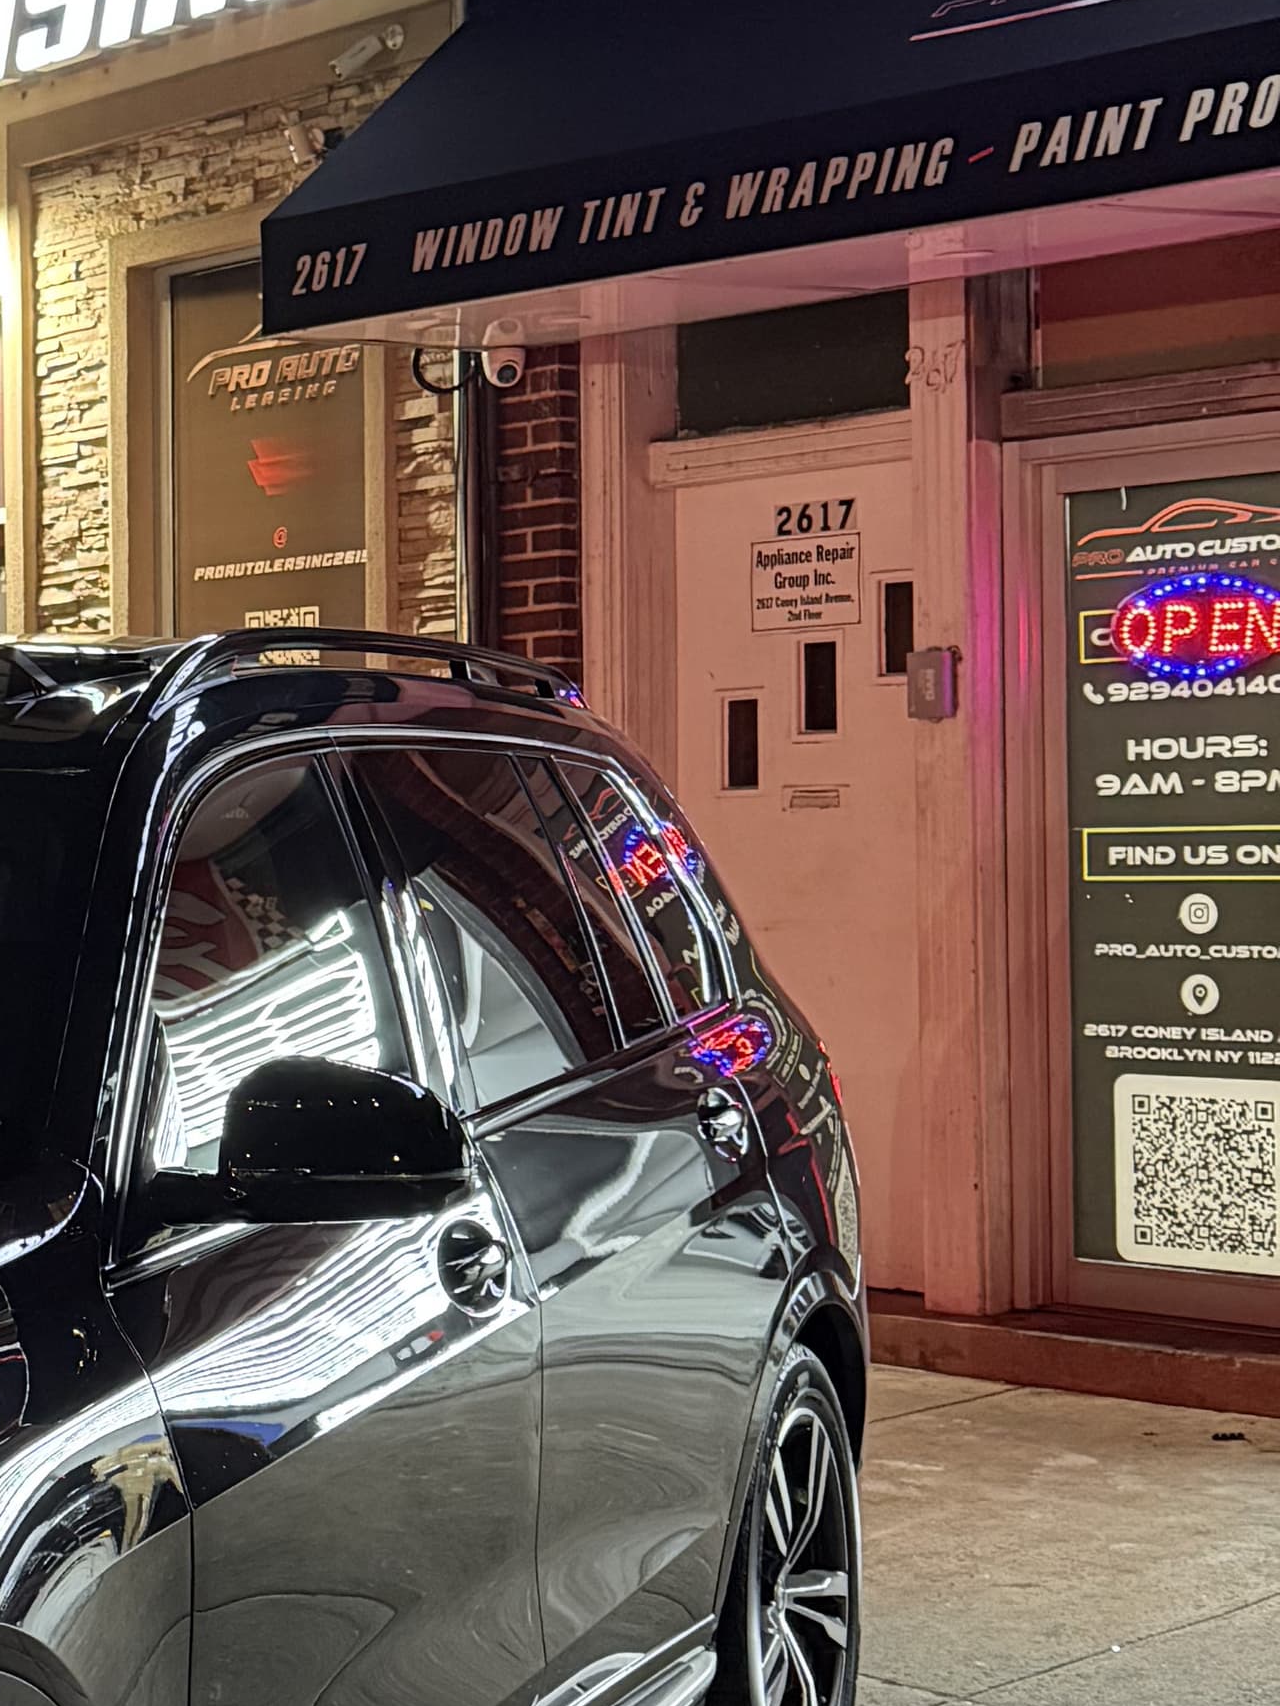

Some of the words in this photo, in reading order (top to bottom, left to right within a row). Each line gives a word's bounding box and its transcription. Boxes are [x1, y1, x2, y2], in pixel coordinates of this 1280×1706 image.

[411, 206, 564, 273] WINDOW
[578, 187, 667, 244] TINT
[680, 181, 706, 229] &
[724, 137, 955, 219] WRAPPING
[1009, 97, 1163, 173] PAINT
[291, 243, 367, 296] 2617
[208, 360, 272, 396] PRO
[275, 344, 361, 384] AUTO
[230, 380, 337, 411] LEASING
[776, 499, 856, 536] 2617
[272, 526, 289, 548] @
[756, 548, 813, 571] Appliance
[816, 541, 856, 565] Repair
[1126, 542, 1196, 563] AUTO
[774, 571, 810, 591] Group
[813, 568, 836, 586] Inc.
[800, 593, 823, 606] Island
[787, 610, 802, 622] 2nd
[1121, 600, 1280, 654] OPEN
[1126, 734, 1268, 761] HOURS:
[1095, 771, 1184, 796] 9AM
[1108, 846, 1177, 866] FIND
[1183, 845, 1229, 865] US
[1236, 844, 1280, 865] ON
[1094, 942, 1280, 961] PRO_AUTO_CUSTO
[1083, 1023, 1129, 1037] 2617
[1131, 1025, 1197, 1041] CONEY
[1200, 1027, 1274, 1043] ISLAND
[1104, 1045, 1212, 1063] BROOKLYN
[1214, 1050, 1244, 1065] NY
